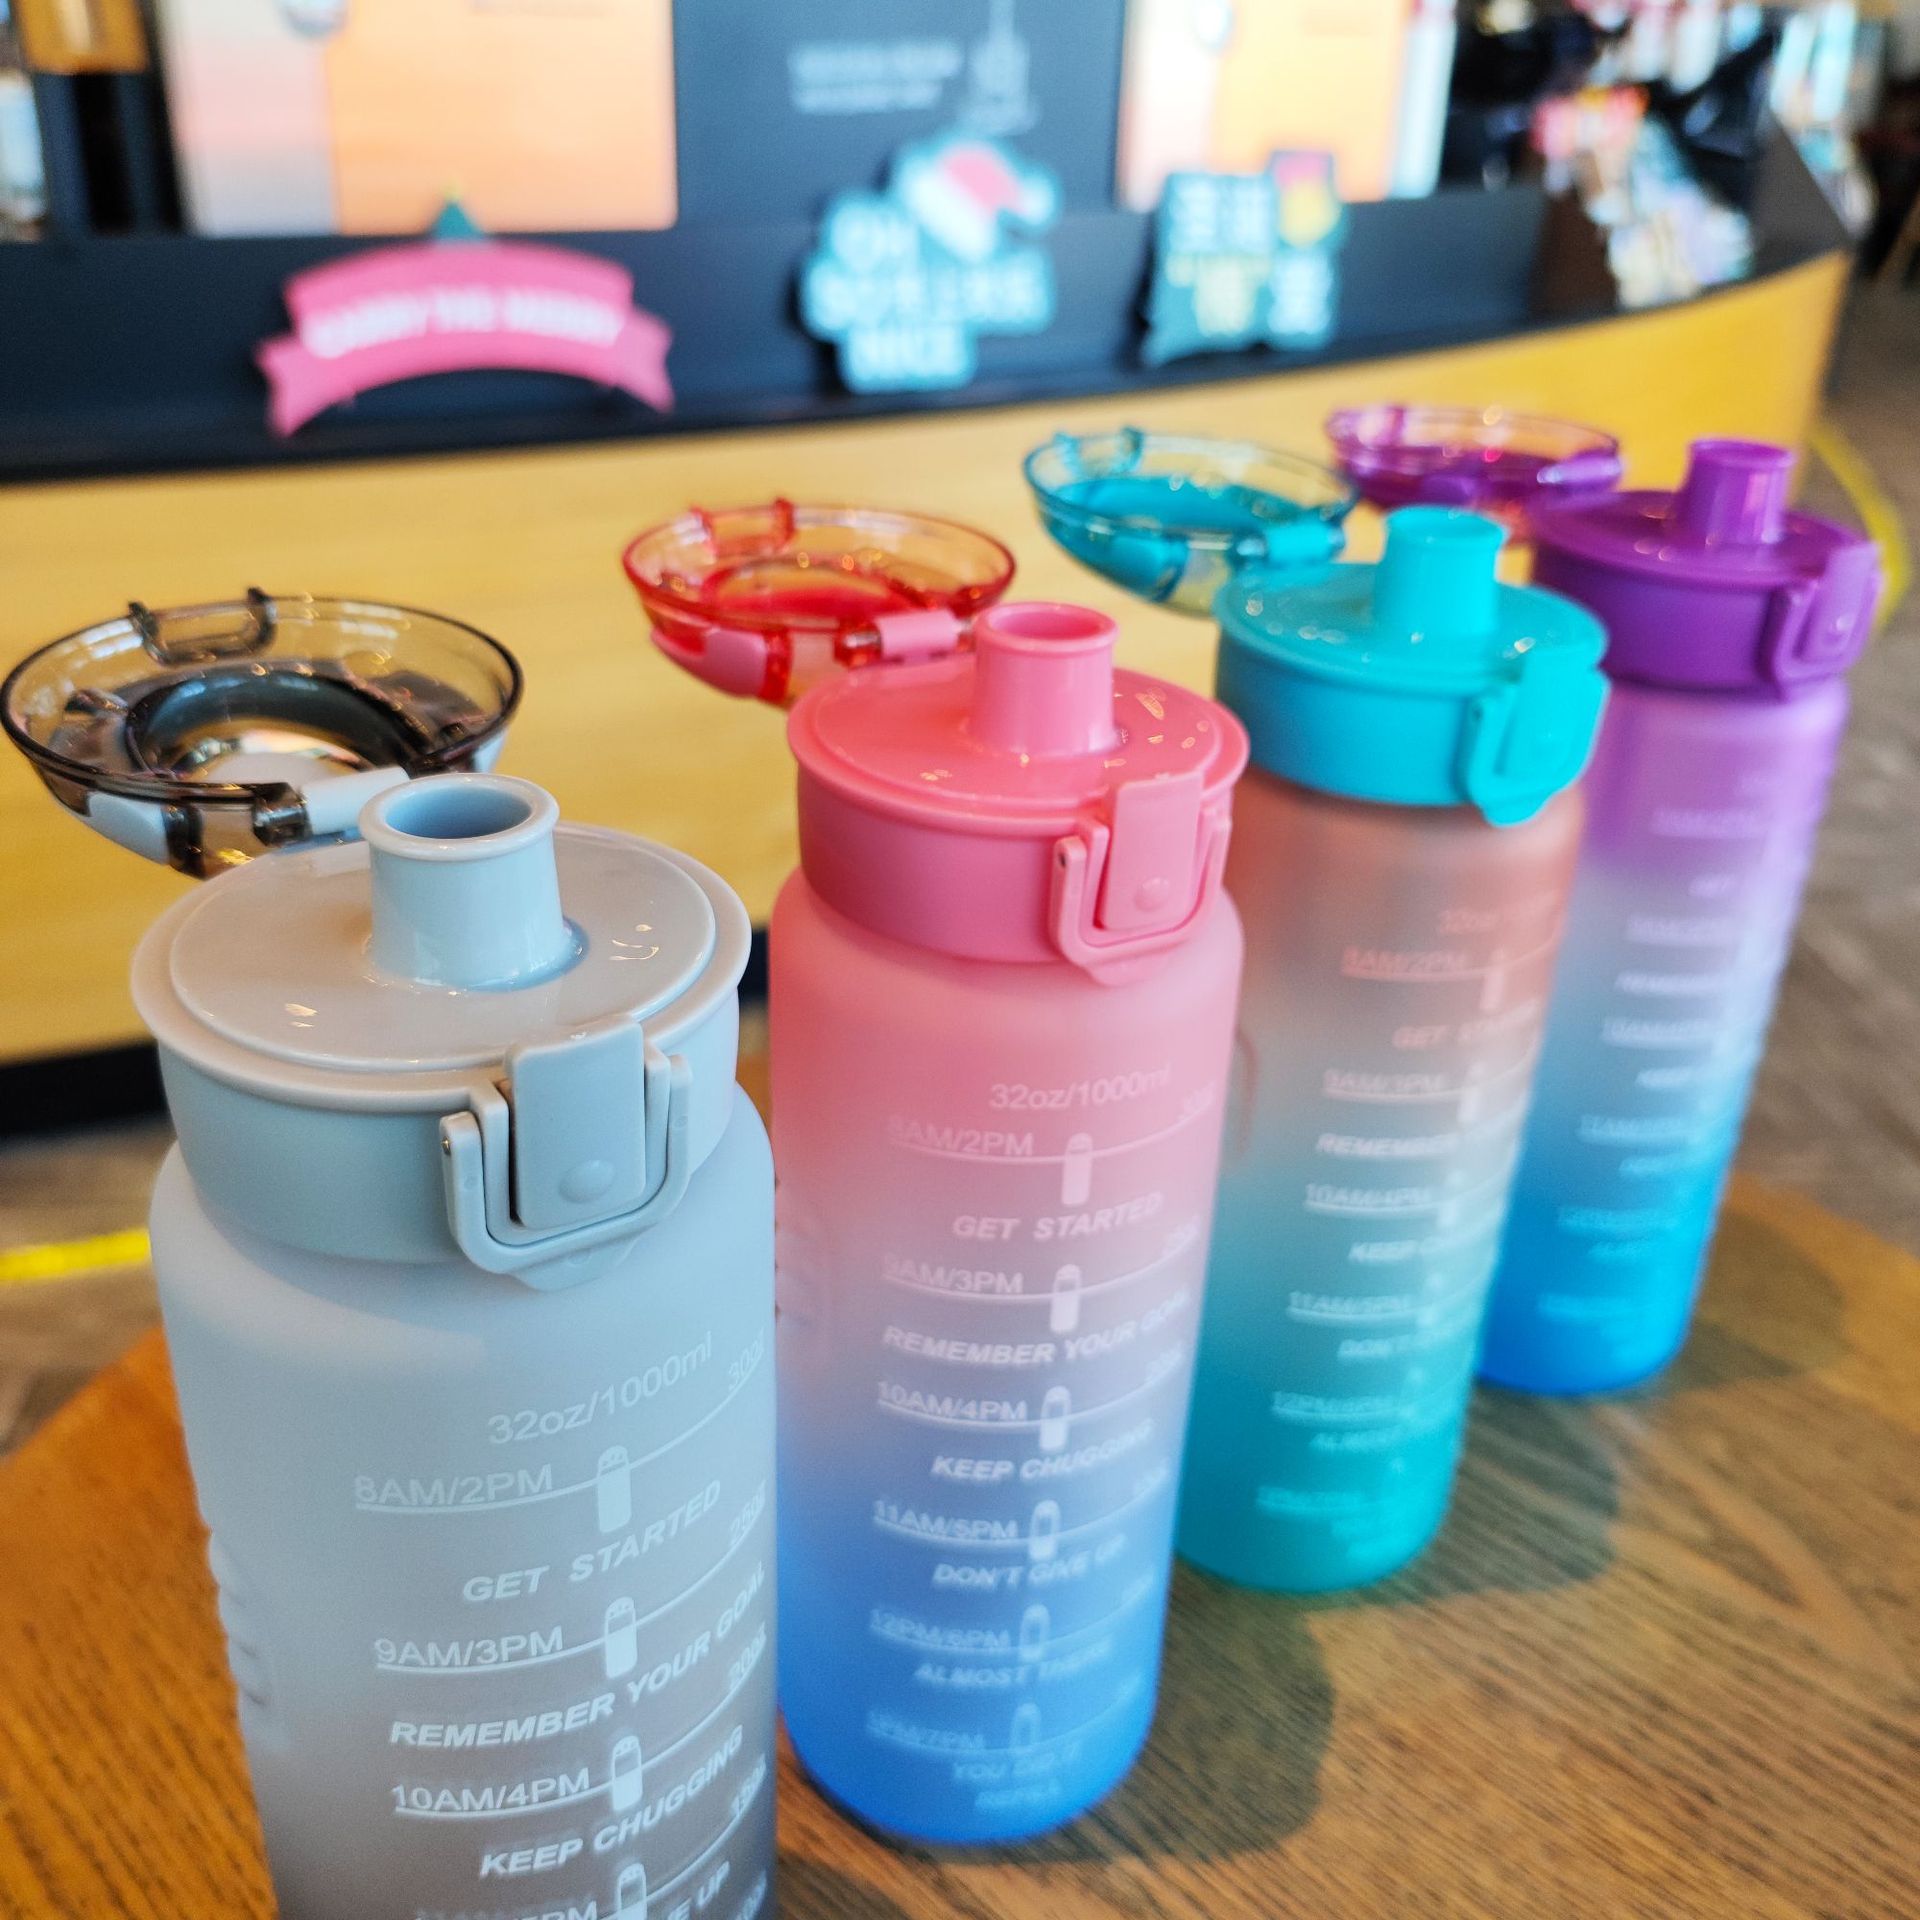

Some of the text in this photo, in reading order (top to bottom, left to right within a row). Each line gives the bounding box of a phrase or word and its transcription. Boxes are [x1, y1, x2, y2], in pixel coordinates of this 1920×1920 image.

[953, 1215, 1020, 1240] GET
[883, 1325, 1056, 1364] REMEMBER
[1064, 1320, 1139, 1360] YOUR
[488, 1331, 712, 1444] 32oz/1000ml
[877, 1381, 1028, 1421] 10AM/4PM
[354, 1464, 553, 1506] 8AM/2PM
[931, 1456, 1015, 1481] KEEP
[462, 1480, 721, 1601] GET STARTED
[374, 1626, 564, 1667] 9AM/3PM
[389, 1692, 616, 1746] REMEMBER
[627, 1630, 711, 1703] YOUR
[392, 1768, 591, 1812] 10AM/4PM
[479, 1725, 743, 1878] KEEP CHUGGING
